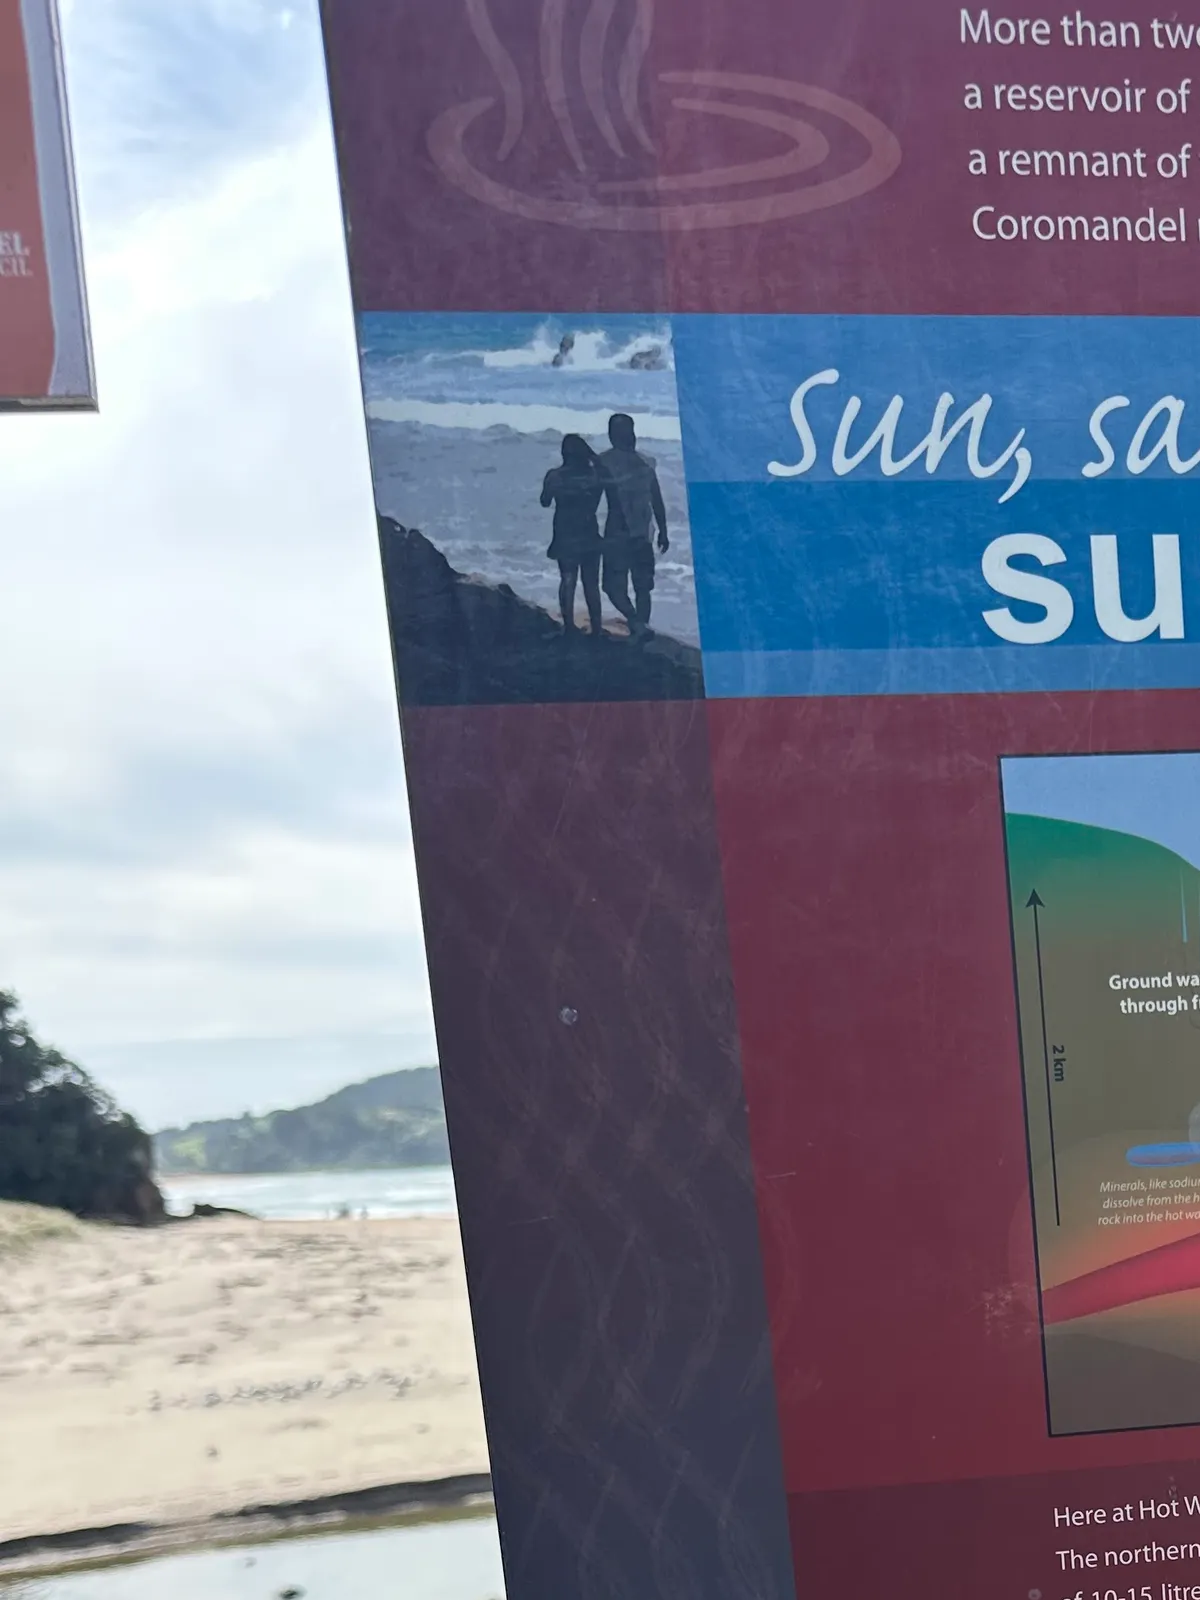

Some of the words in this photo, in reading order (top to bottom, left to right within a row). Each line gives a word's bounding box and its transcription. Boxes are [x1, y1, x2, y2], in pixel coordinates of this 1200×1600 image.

[959, 8, 1050, 45] More
[1059, 10, 1140, 47] than
[963, 83, 982, 109] a
[993, 78, 1146, 112] reservoir
[1155, 77, 1191, 113] of
[972, 205, 1185, 242] Coromandel
[1108, 971, 1172, 990] Ground
[1119, 994, 1188, 1015] through
[1052, 1044, 1065, 1055] 2
[1053, 1058, 1067, 1082] km
[1148, 1177, 1167, 1189] like
[1101, 1195, 1144, 1209] dissolve
[1146, 1193, 1171, 1206] from
[1173, 1192, 1191, 1204] the
[1097, 1213, 1120, 1225] rock
[1122, 1213, 1144, 1223] into
[1145, 1211, 1163, 1223] the
[1164, 1209, 1183, 1221] hot
[1053, 1506, 1106, 1527] Here
[1111, 1503, 1134, 1522] at
[1138, 1498, 1179, 1520] Hot
[1054, 1548, 1098, 1570] The
